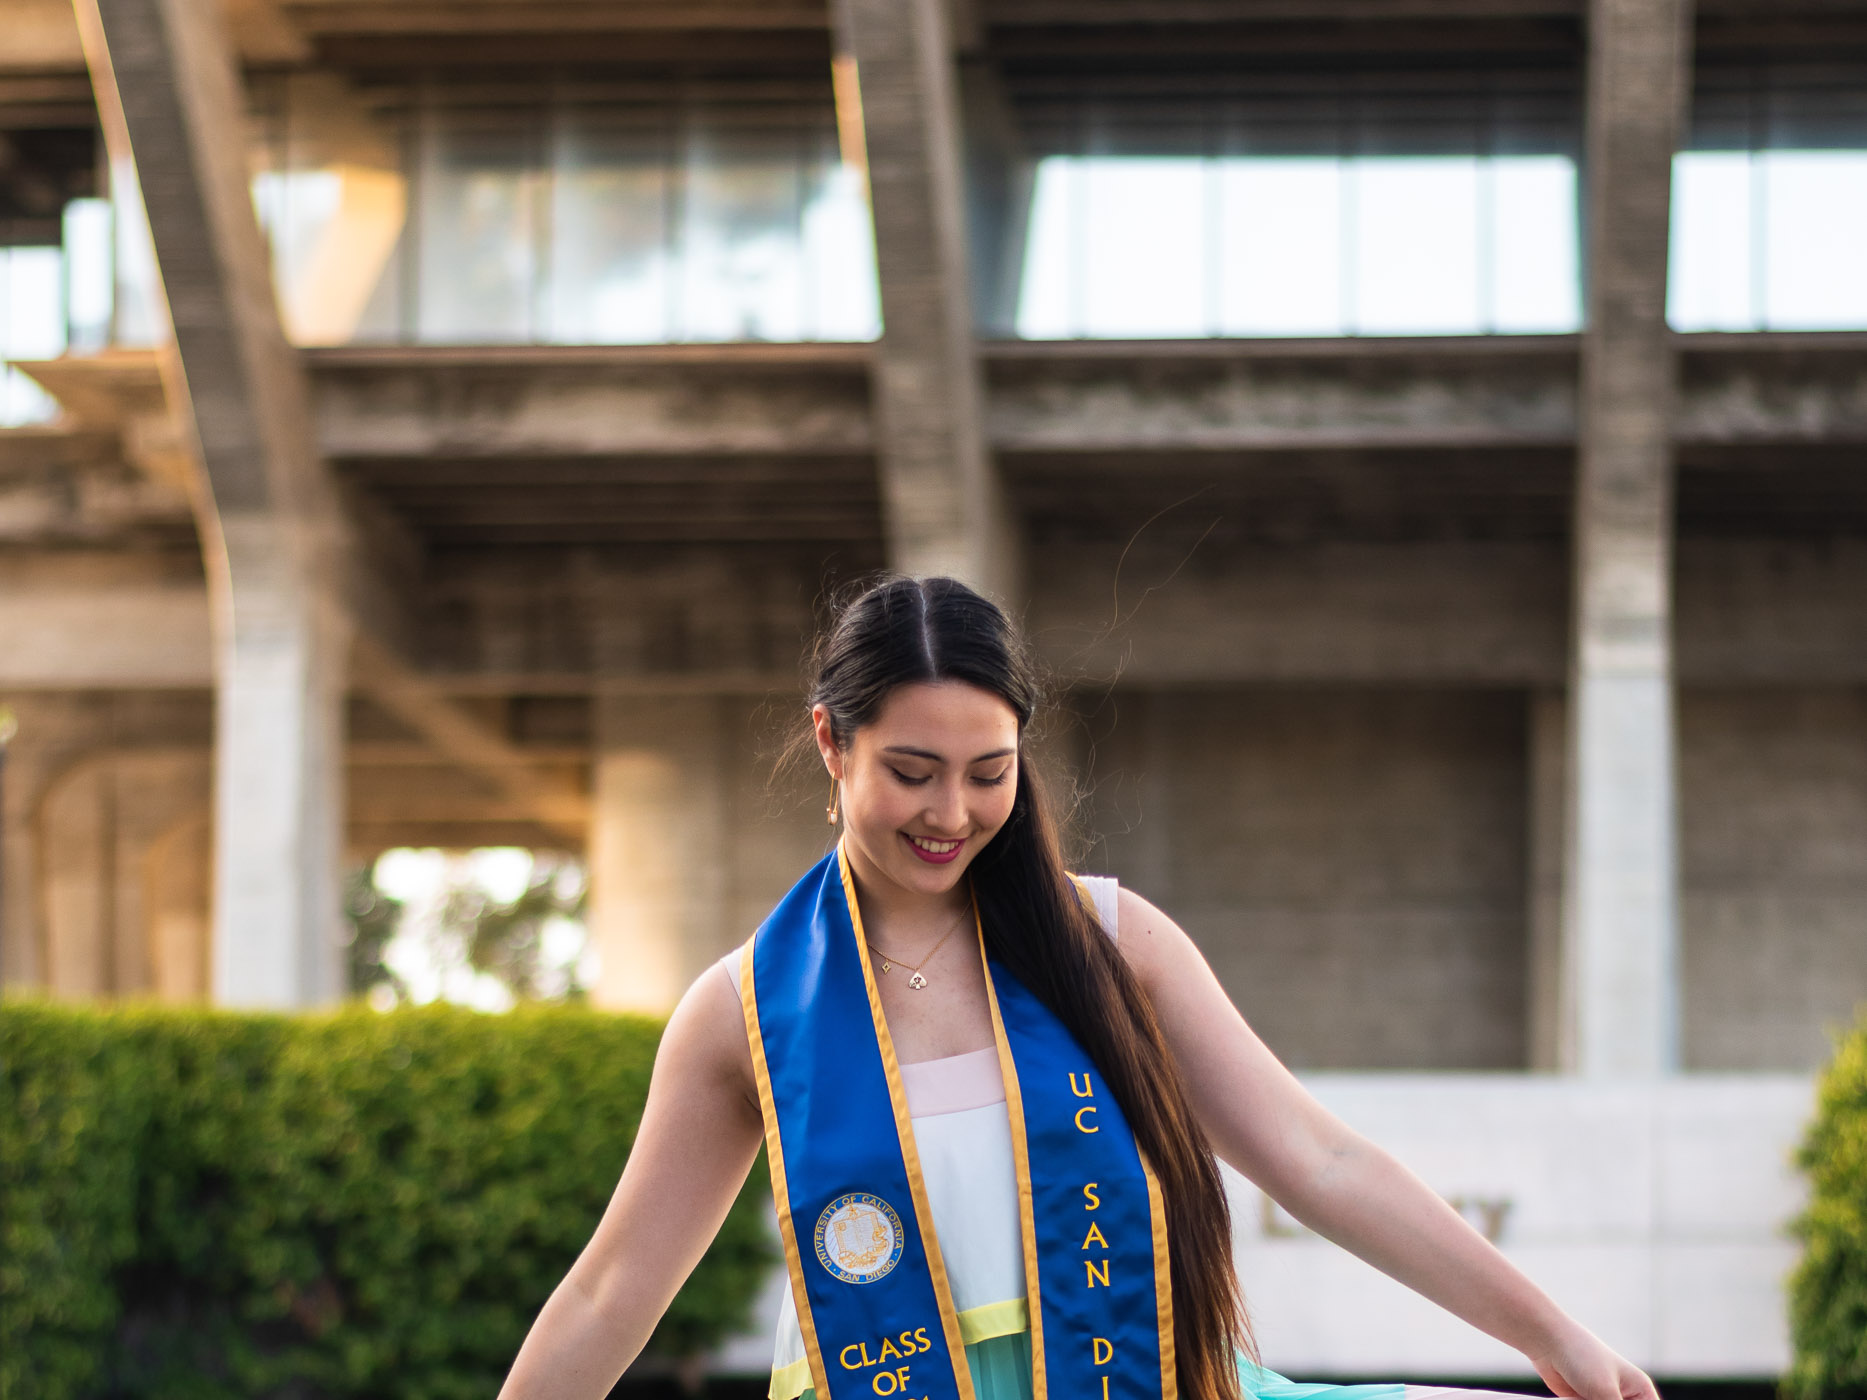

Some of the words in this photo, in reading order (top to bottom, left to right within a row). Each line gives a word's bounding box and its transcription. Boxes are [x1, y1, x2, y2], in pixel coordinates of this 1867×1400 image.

[1068, 1072, 1099, 1134] UC
[816, 1205, 839, 1268] UNIVERSITY
[842, 1196, 857, 1205] OF
[862, 1196, 903, 1249] CALIFORNIA
[1081, 1182, 1111, 1289] SAN
[838, 1270, 860, 1281] SAN
[865, 1259, 895, 1281] DIEGO
[840, 1327, 931, 1370] CLASS
[872, 1366, 911, 1396] OF
